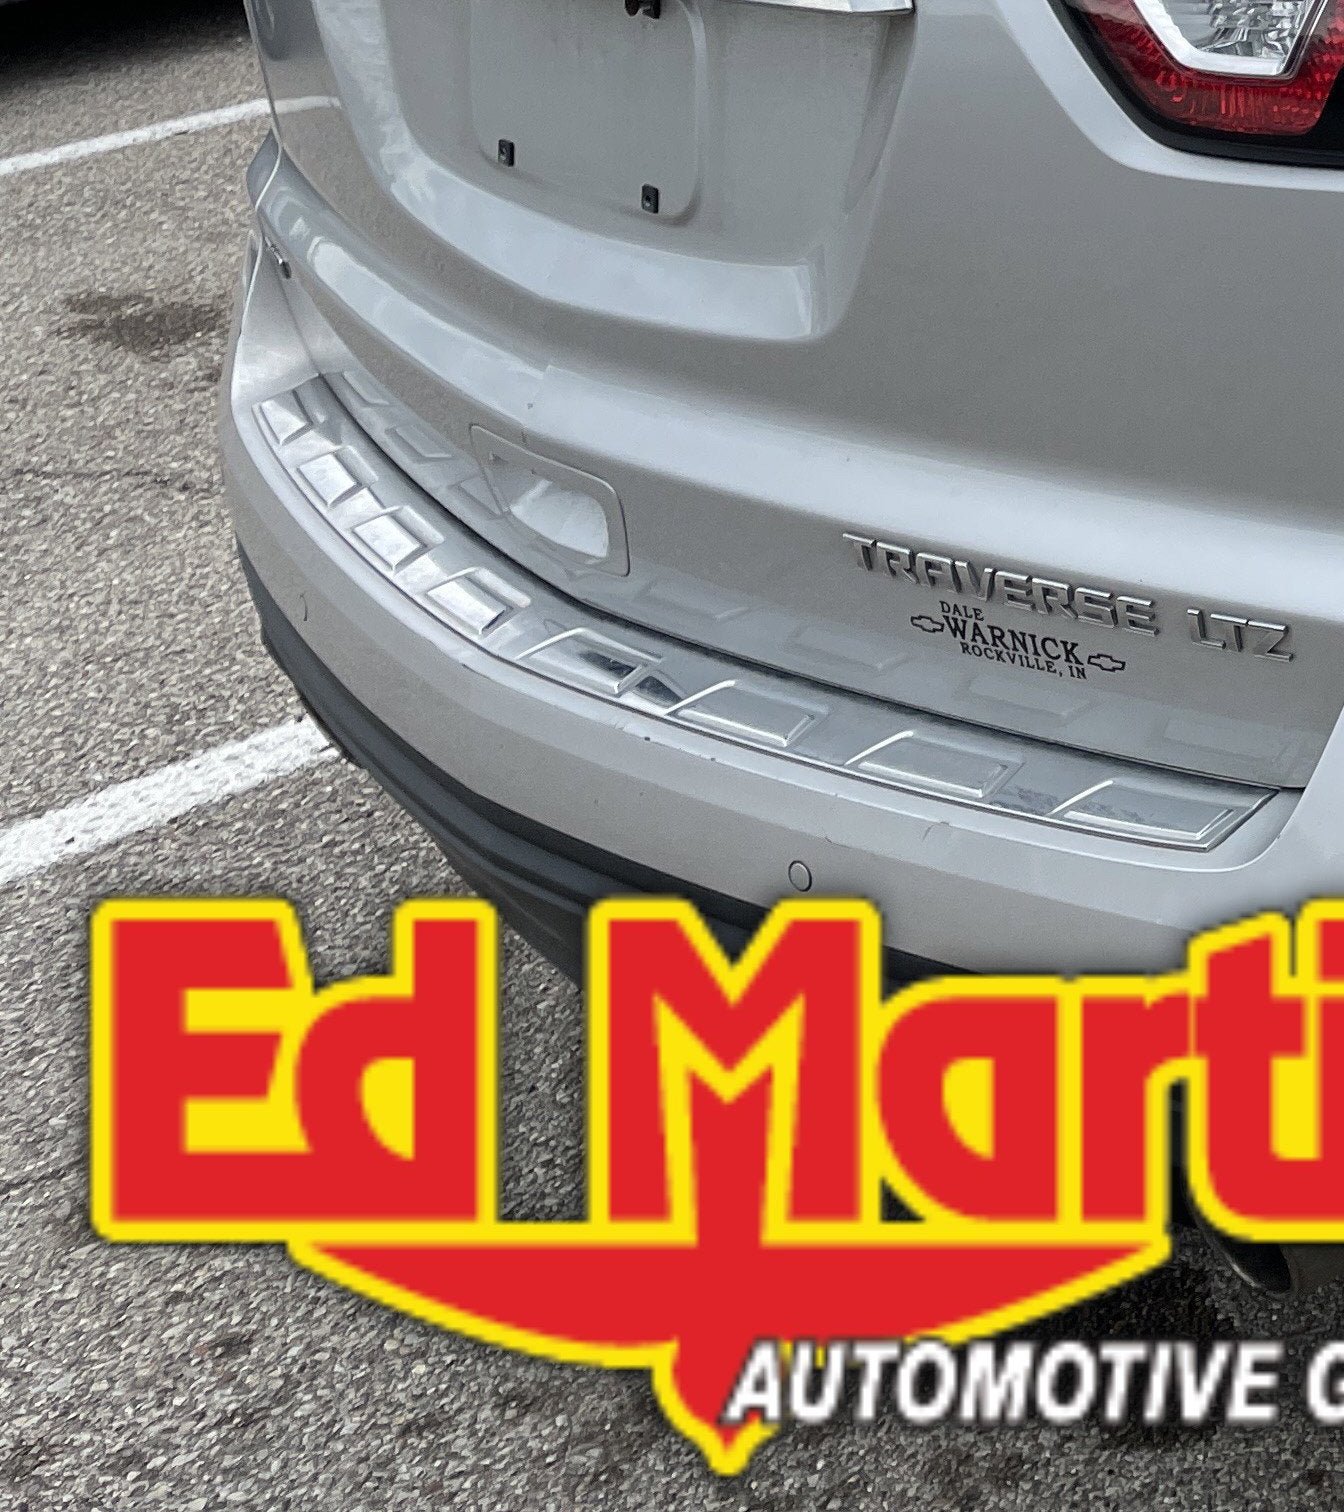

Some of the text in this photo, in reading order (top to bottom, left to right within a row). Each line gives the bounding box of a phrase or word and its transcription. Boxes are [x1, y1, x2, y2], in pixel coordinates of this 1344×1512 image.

[842, 532, 1294, 662] TRAVERSE LTZ
[939, 600, 985, 621] DALE
[943, 615, 1084, 665] WARNICK
[960, 641, 1088, 680] ROCKVILLE, IN
